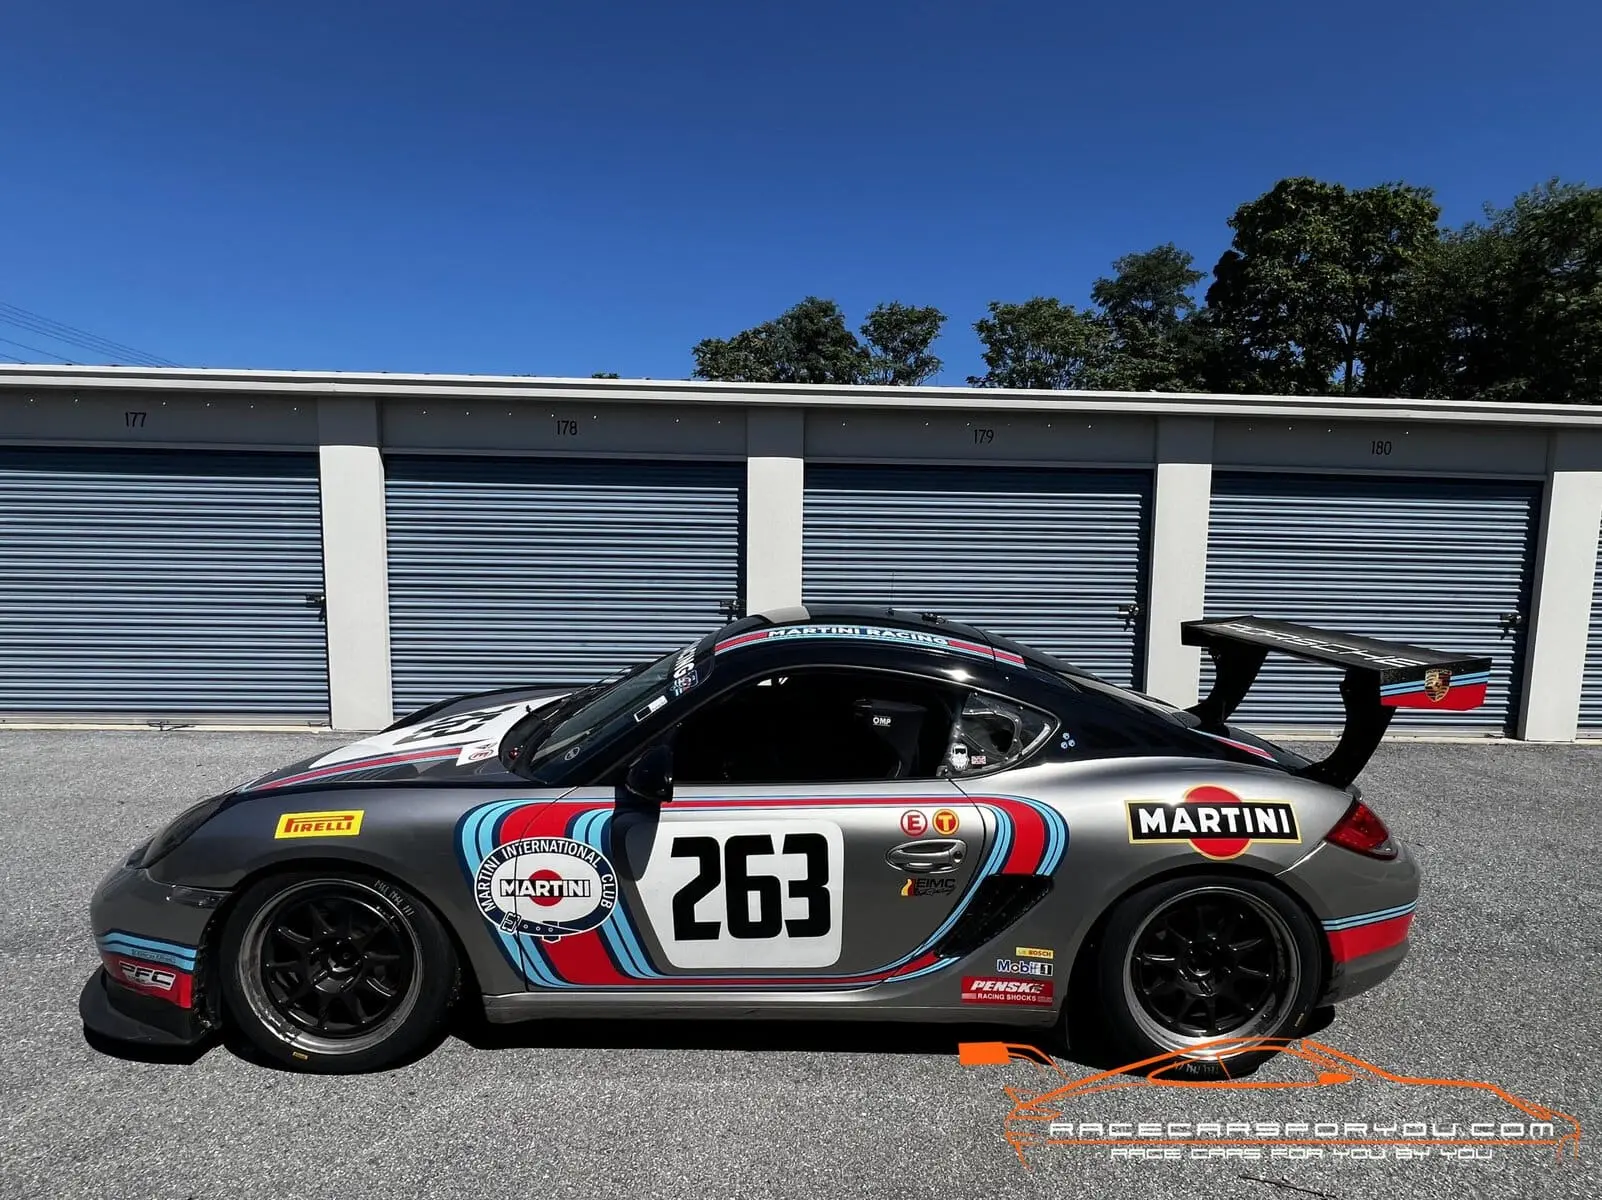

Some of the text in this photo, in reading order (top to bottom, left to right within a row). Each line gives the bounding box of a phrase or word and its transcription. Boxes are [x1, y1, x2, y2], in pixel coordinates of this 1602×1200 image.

[125, 411, 147, 428] 177
[556, 420, 578, 436] 178
[973, 429, 994, 445] 179
[1371, 440, 1392, 456] 180
[768, 626, 949, 645] MARTINI RACING
[1215, 623, 1429, 668] PORSCHE
[872, 716, 891, 726] OMP
[284, 815, 355, 833] PIRELLI
[907, 814, 921, 831] E
[937, 814, 954, 831] T
[1138, 807, 1291, 834] MARTINI
[477, 839, 617, 913] MARTINI INTERNATIONAL CLUB
[916, 878, 956, 888] EIMC
[501, 880, 590, 897] MARTINI
[670, 833, 831, 941] 263
[1028, 949, 1052, 957] BOSCH
[970, 980, 1045, 993] PENSKE
